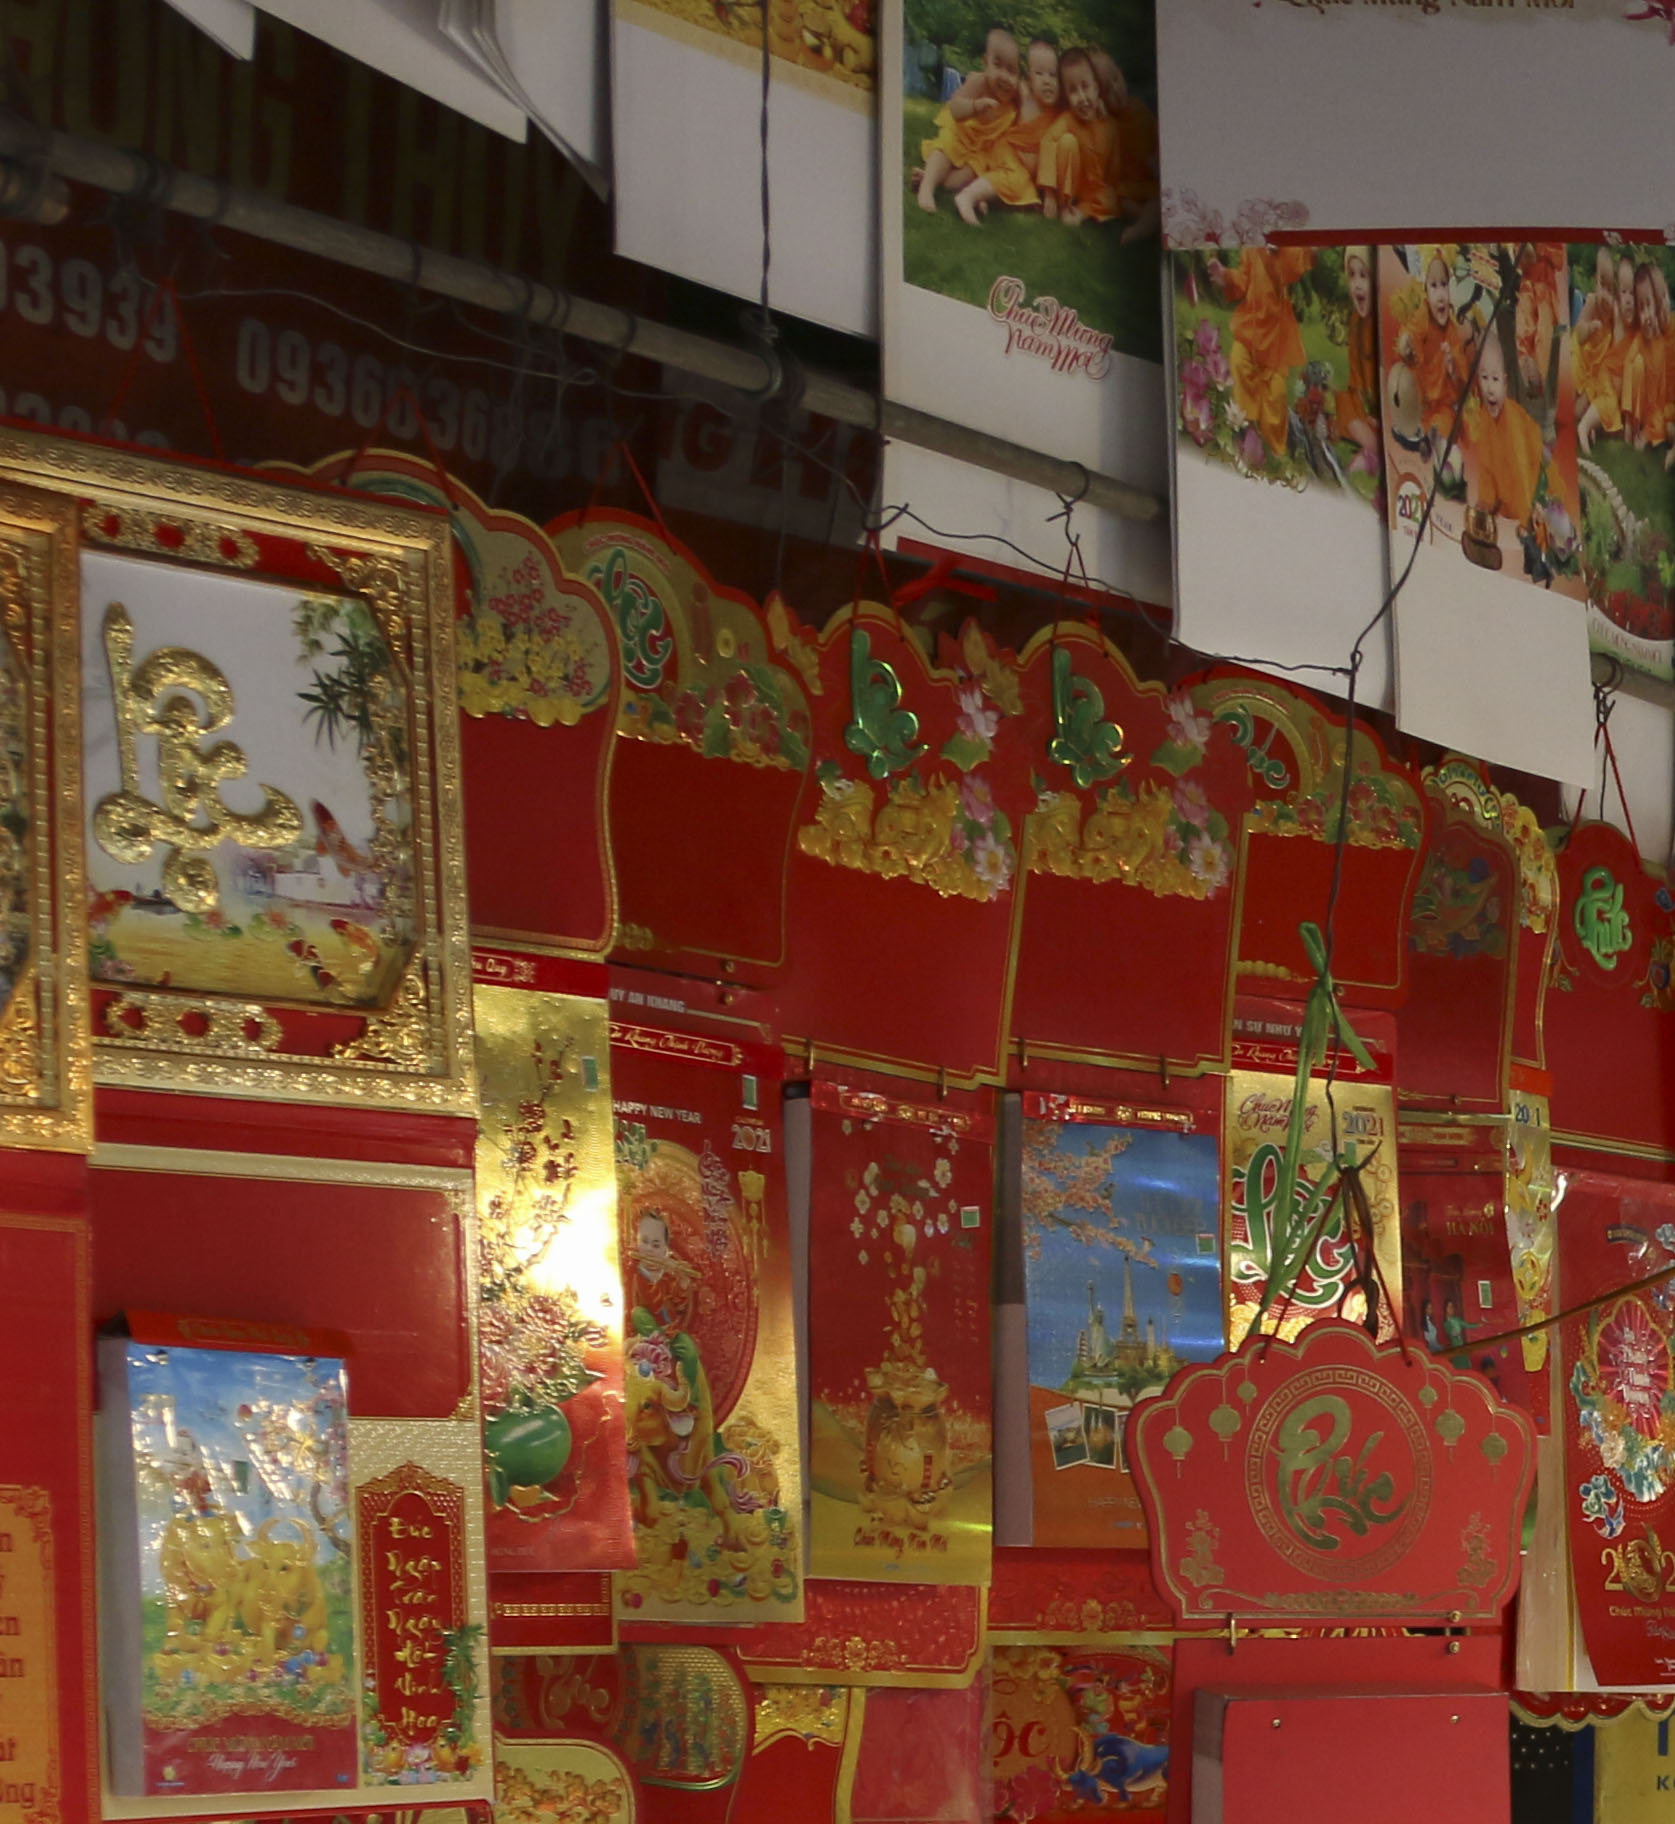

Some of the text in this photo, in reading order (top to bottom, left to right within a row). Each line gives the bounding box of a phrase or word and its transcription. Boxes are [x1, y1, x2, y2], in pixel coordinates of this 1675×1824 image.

[612, 1100, 703, 1124] HAPPY NEW YEAR
[731, 1122, 773, 1153] 2021
